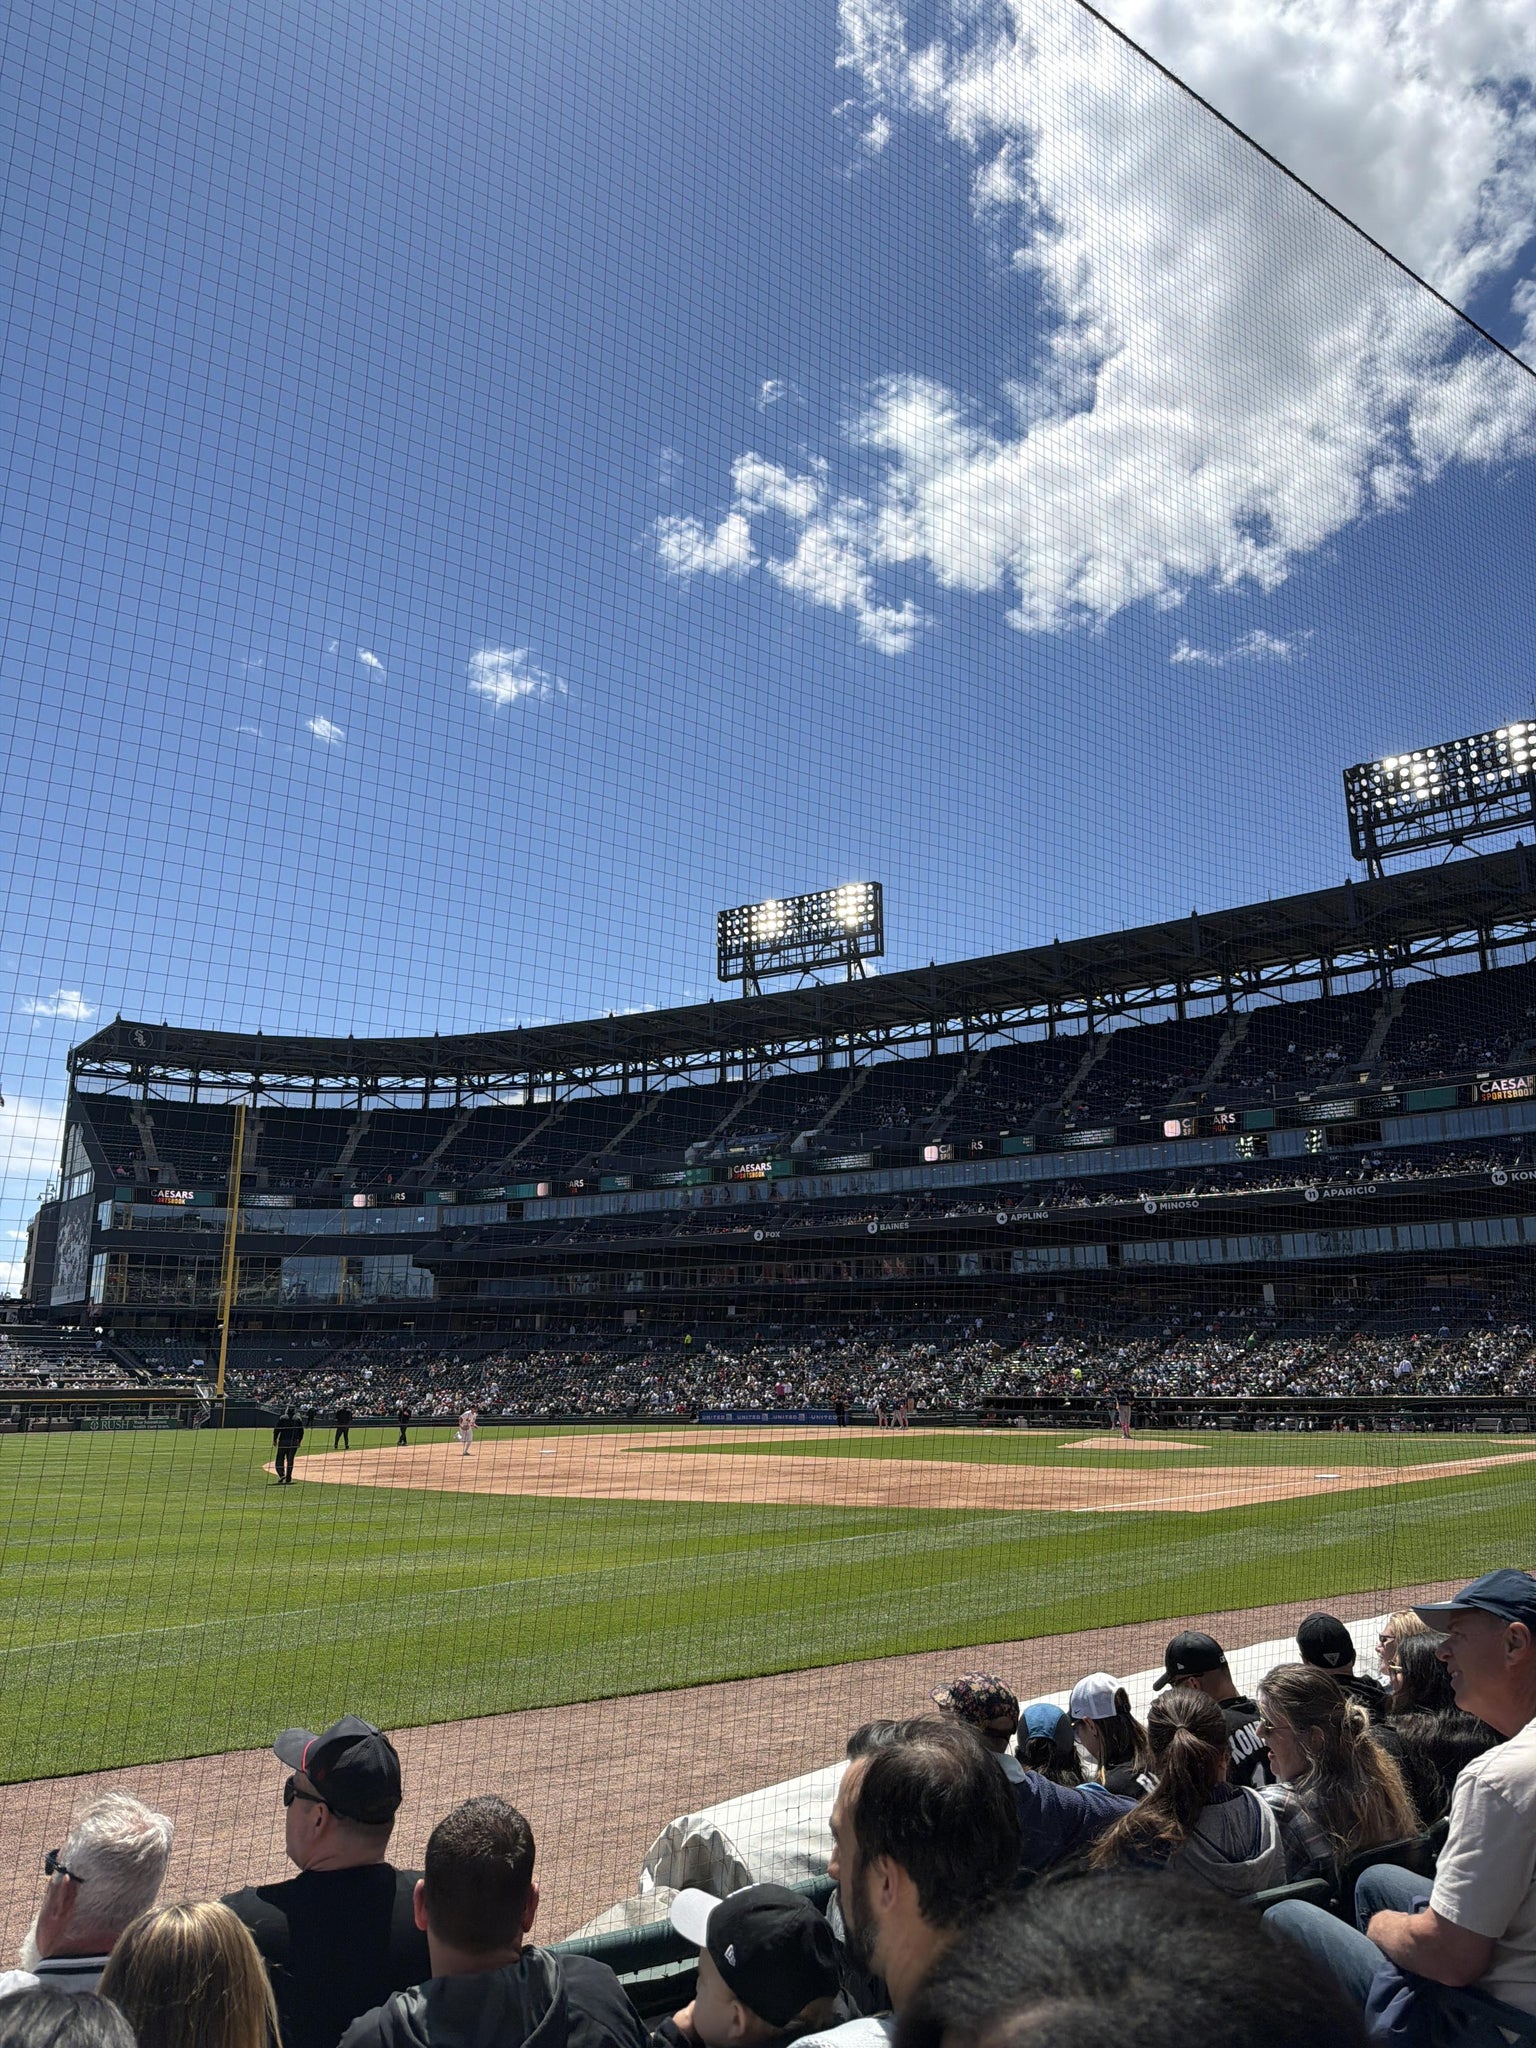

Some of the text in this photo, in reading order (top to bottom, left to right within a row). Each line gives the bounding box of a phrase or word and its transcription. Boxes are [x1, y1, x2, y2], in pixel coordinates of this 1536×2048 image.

[733, 1162, 772, 1173] CAESARS
[150, 1189, 194, 1199] CAESARS
[1322, 1185, 1376, 1198] APARICIO
[1160, 1200, 1199, 1210] MINOSO
[1010, 1211, 1049, 1221] APPLING
[880, 1222, 910, 1231] BAINES
